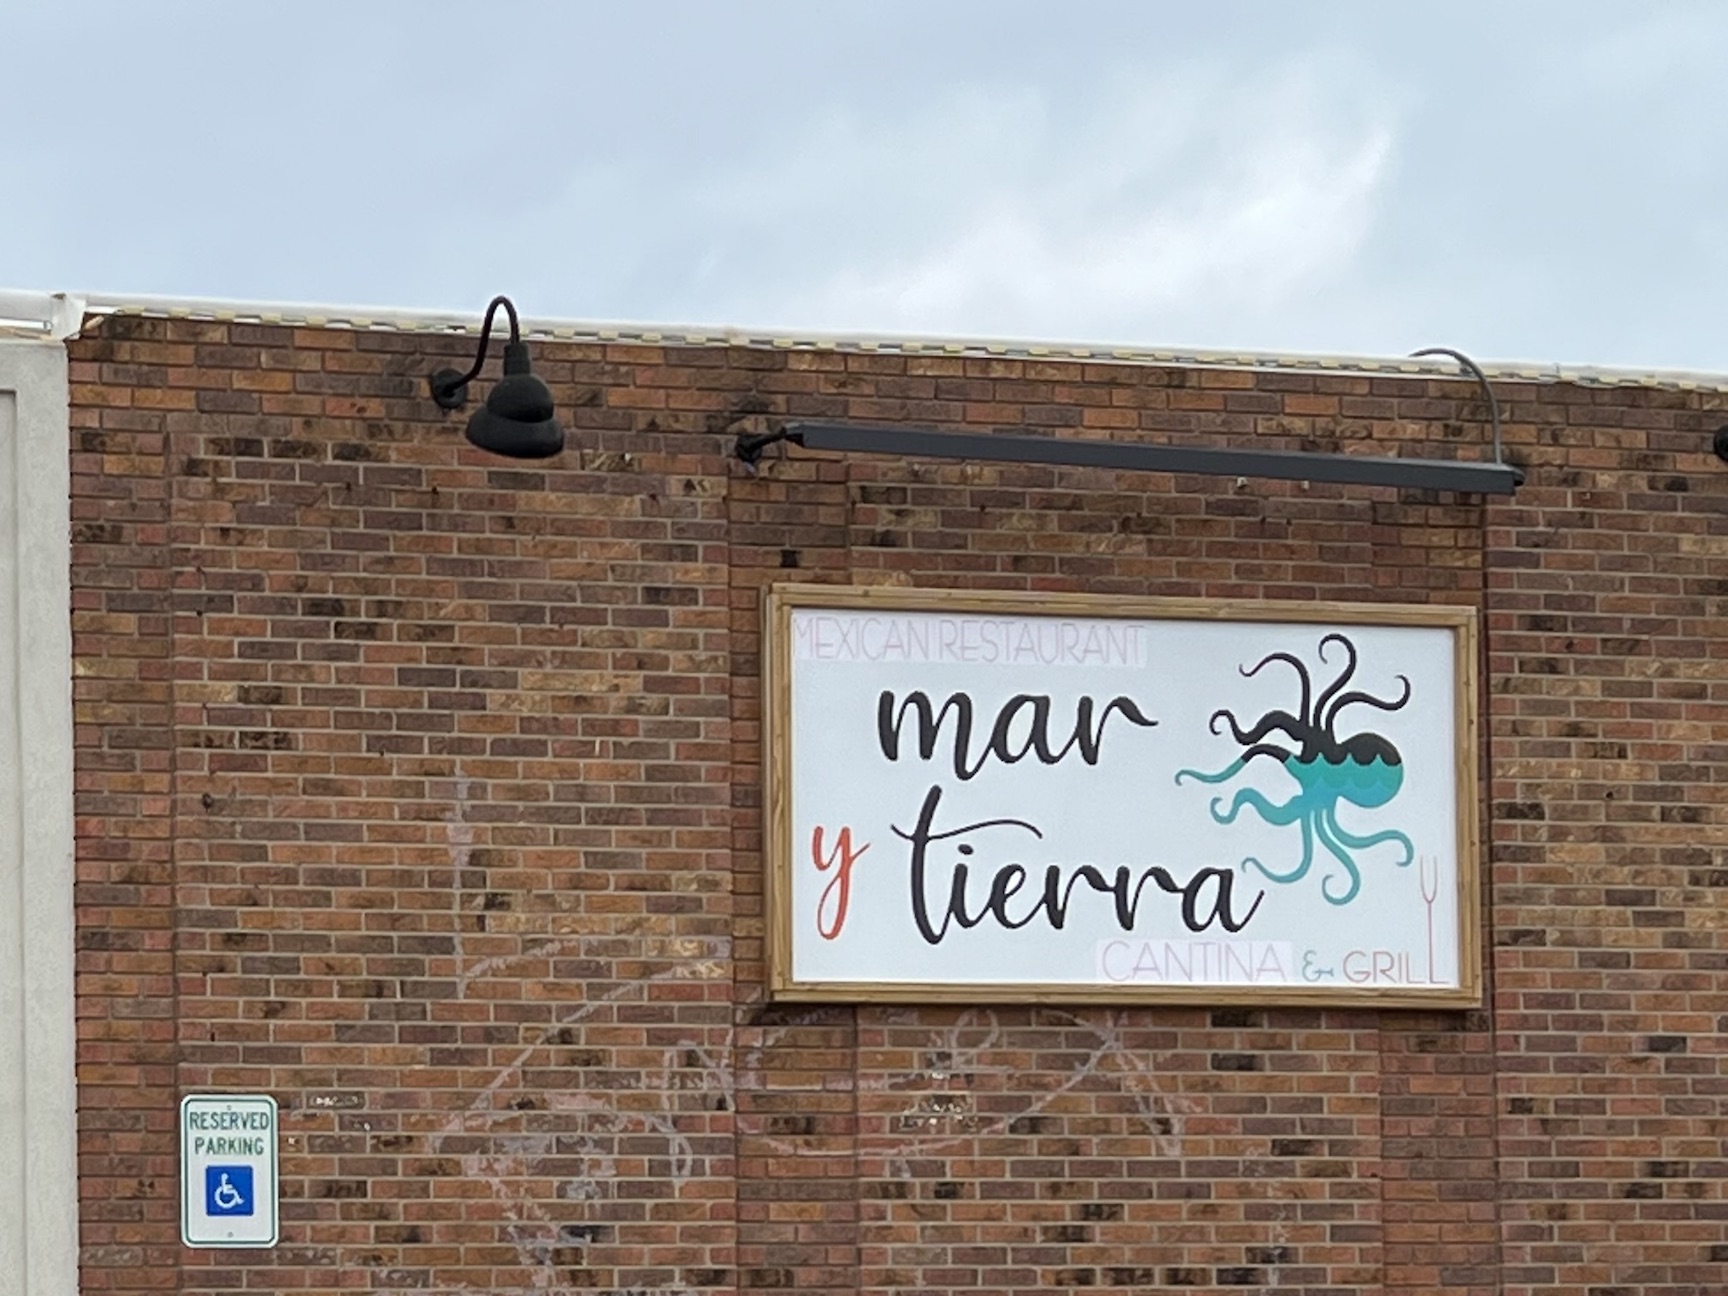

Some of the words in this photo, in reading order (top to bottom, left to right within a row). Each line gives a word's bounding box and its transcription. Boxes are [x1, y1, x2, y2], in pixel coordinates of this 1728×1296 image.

[939, 618, 1146, 665] RESTAURANT
[878, 690, 1158, 781] mar
[812, 824, 871, 941] y
[891, 785, 1264, 945] tierra
[1101, 940, 1289, 983] CANTINA
[1302, 950, 1335, 982] &
[189, 1111, 270, 1131] RESERVED
[194, 1136, 265, 1156] PARKING
